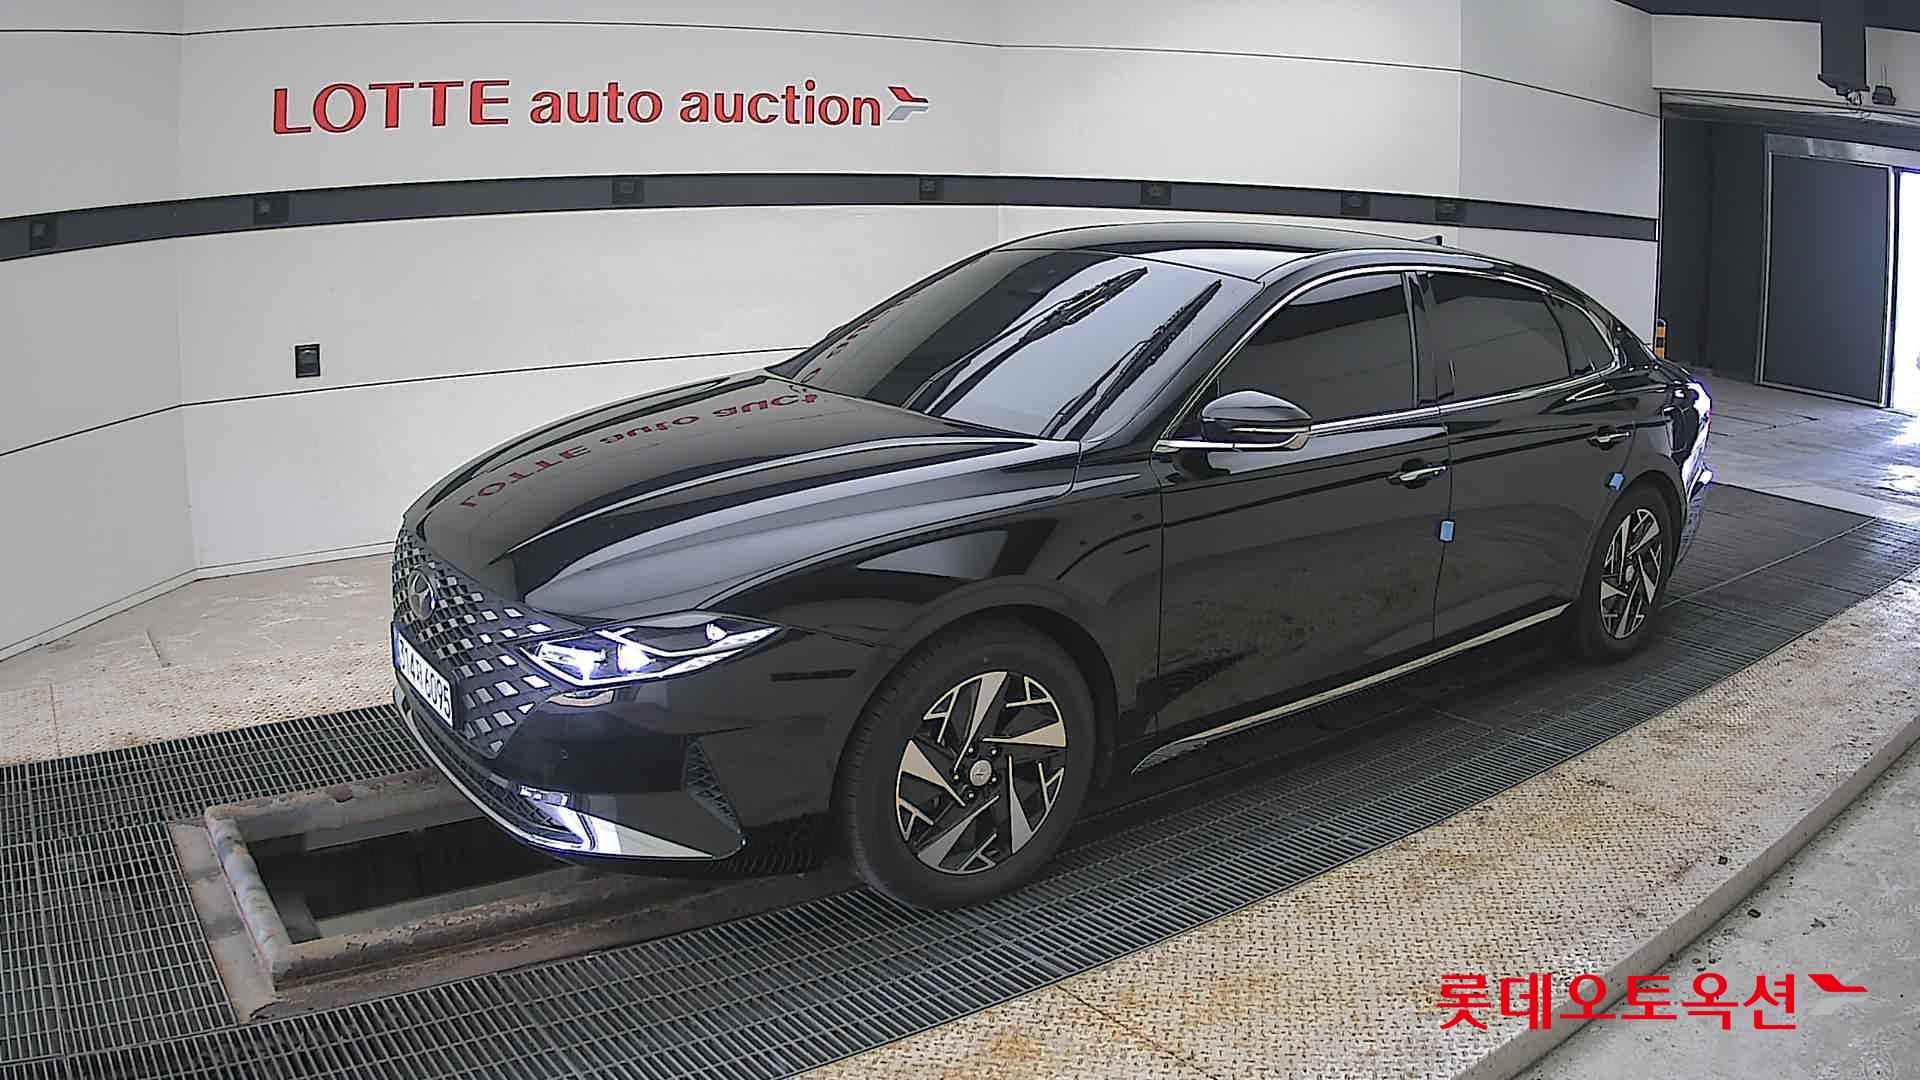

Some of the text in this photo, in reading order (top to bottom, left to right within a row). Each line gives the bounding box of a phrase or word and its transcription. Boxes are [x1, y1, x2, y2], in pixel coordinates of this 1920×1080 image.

[272, 79, 882, 136] LOTTE auto auction
